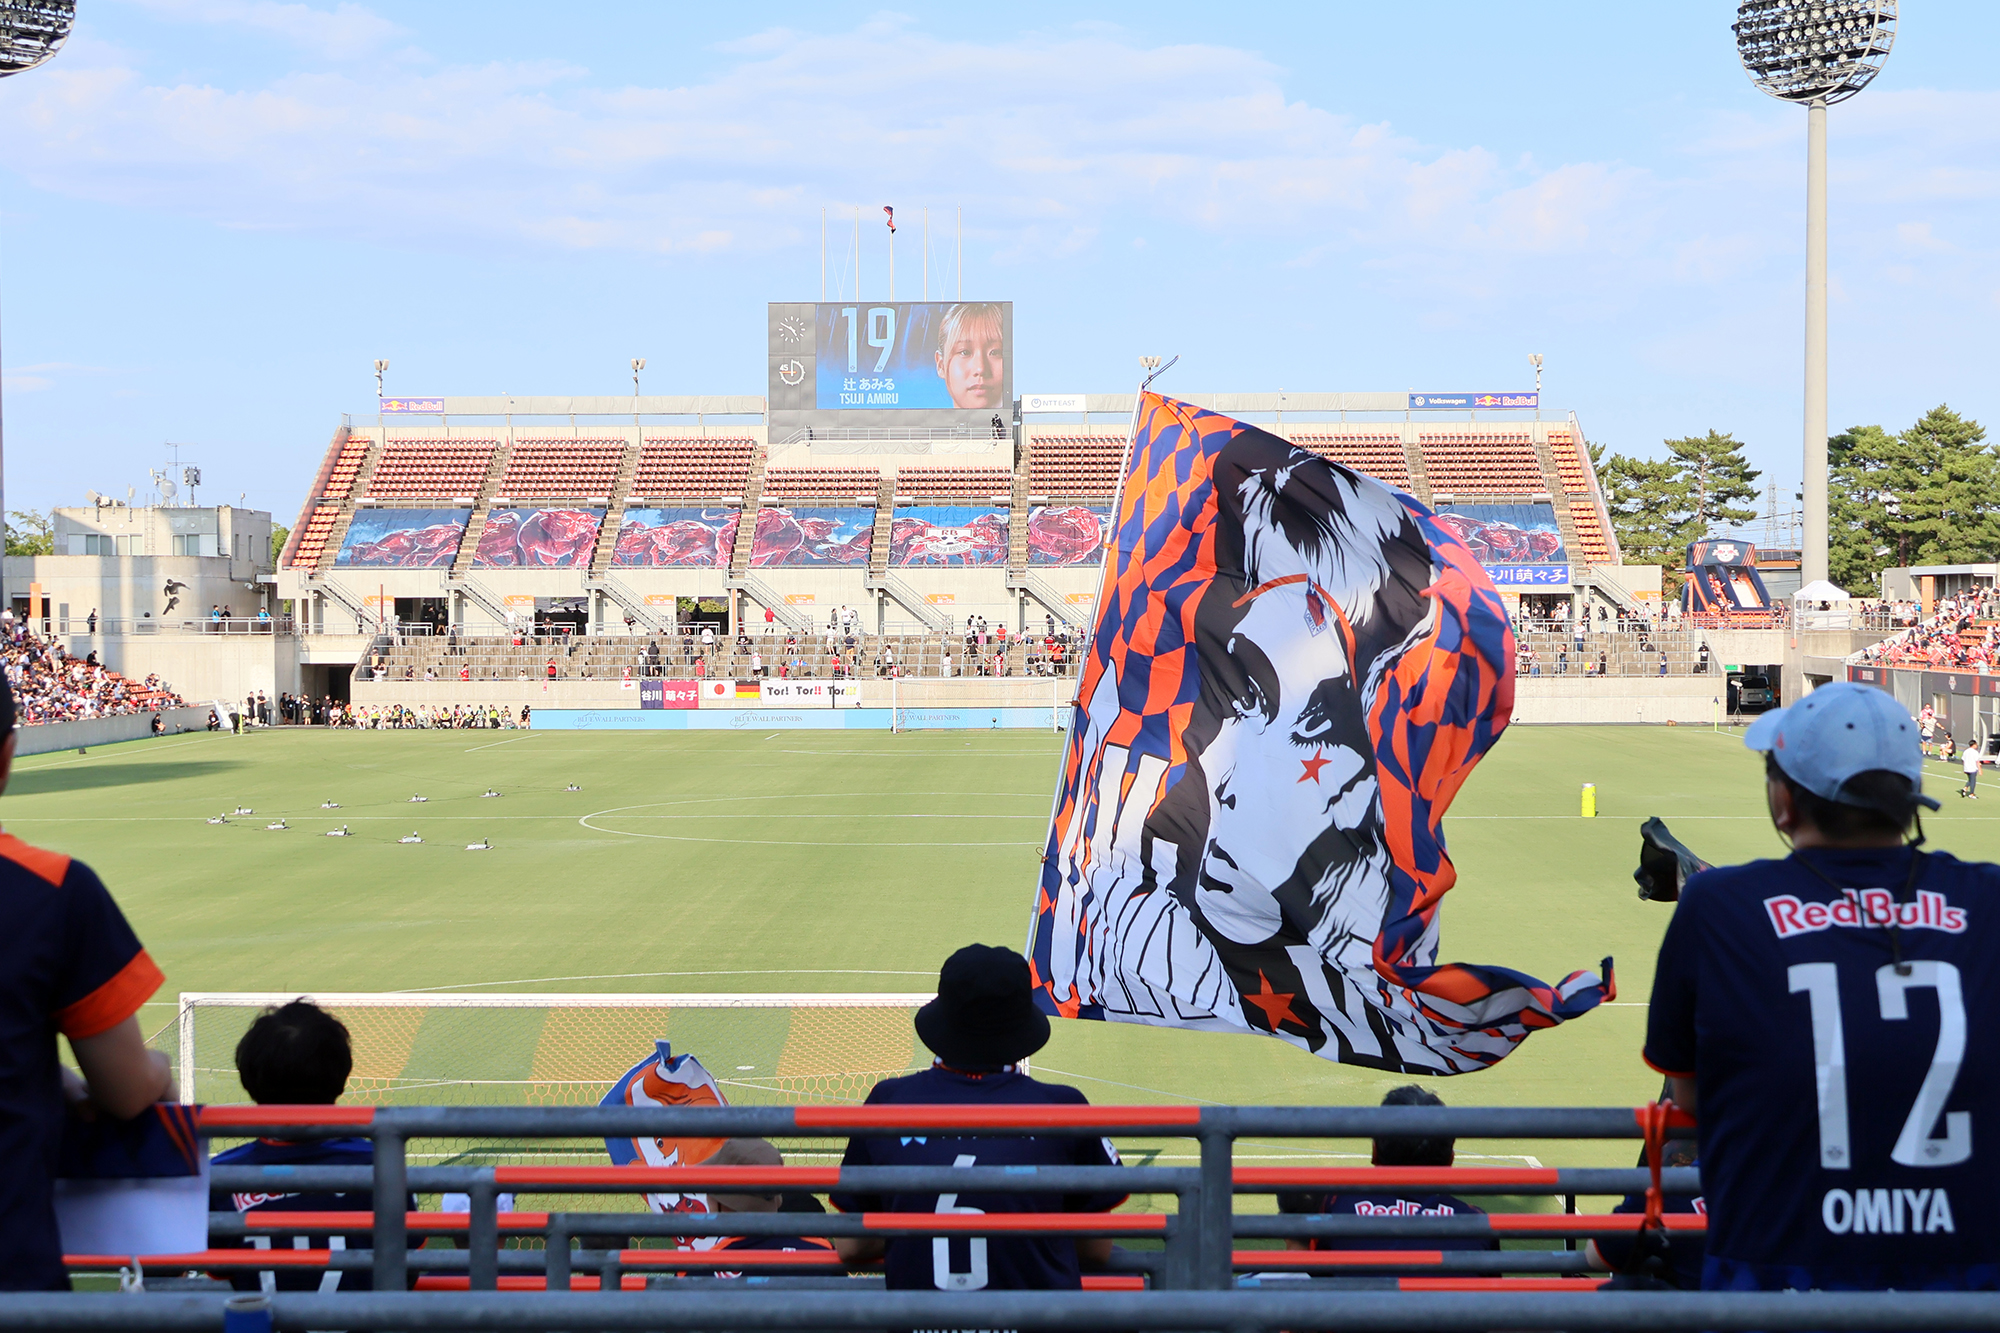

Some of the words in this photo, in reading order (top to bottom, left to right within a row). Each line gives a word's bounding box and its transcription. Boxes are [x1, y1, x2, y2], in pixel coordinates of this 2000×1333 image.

[842, 307, 895, 373] 19
[859, 377, 895, 391] あみる
[840, 393, 864, 404] TSUJI
[867, 393, 899, 404] AMIRU
[641, 689, 662, 702] 谷川
[665, 689, 698, 702] 萌々子
[767, 686, 789, 696] Tor!
[796, 685, 822, 696] Tor!!
[827, 685, 857, 696] Tor!!!
[1787, 960, 1972, 1171] 12
[1821, 1187, 1955, 1235] OMIYA
